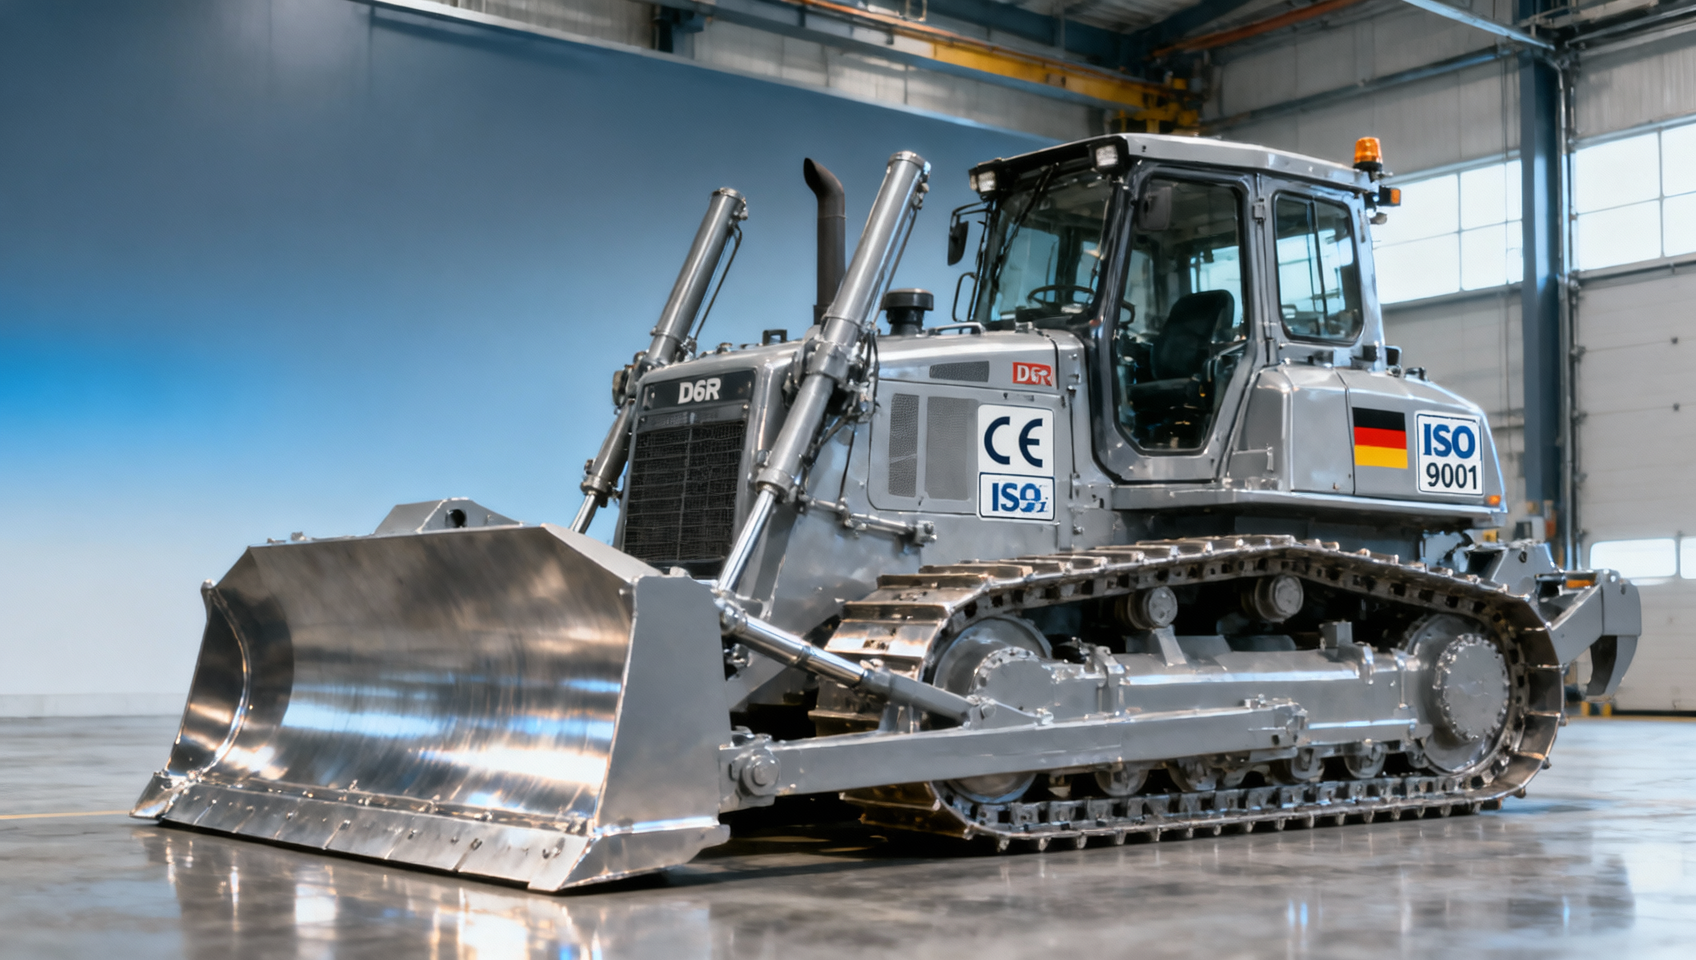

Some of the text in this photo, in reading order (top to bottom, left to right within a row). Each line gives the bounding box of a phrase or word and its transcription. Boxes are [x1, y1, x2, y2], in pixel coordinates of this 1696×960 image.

[677, 377, 721, 404] D6R
[984, 416, 1043, 468] CE
[1423, 423, 1476, 459] ISO
[1426, 462, 1477, 490] 9001
